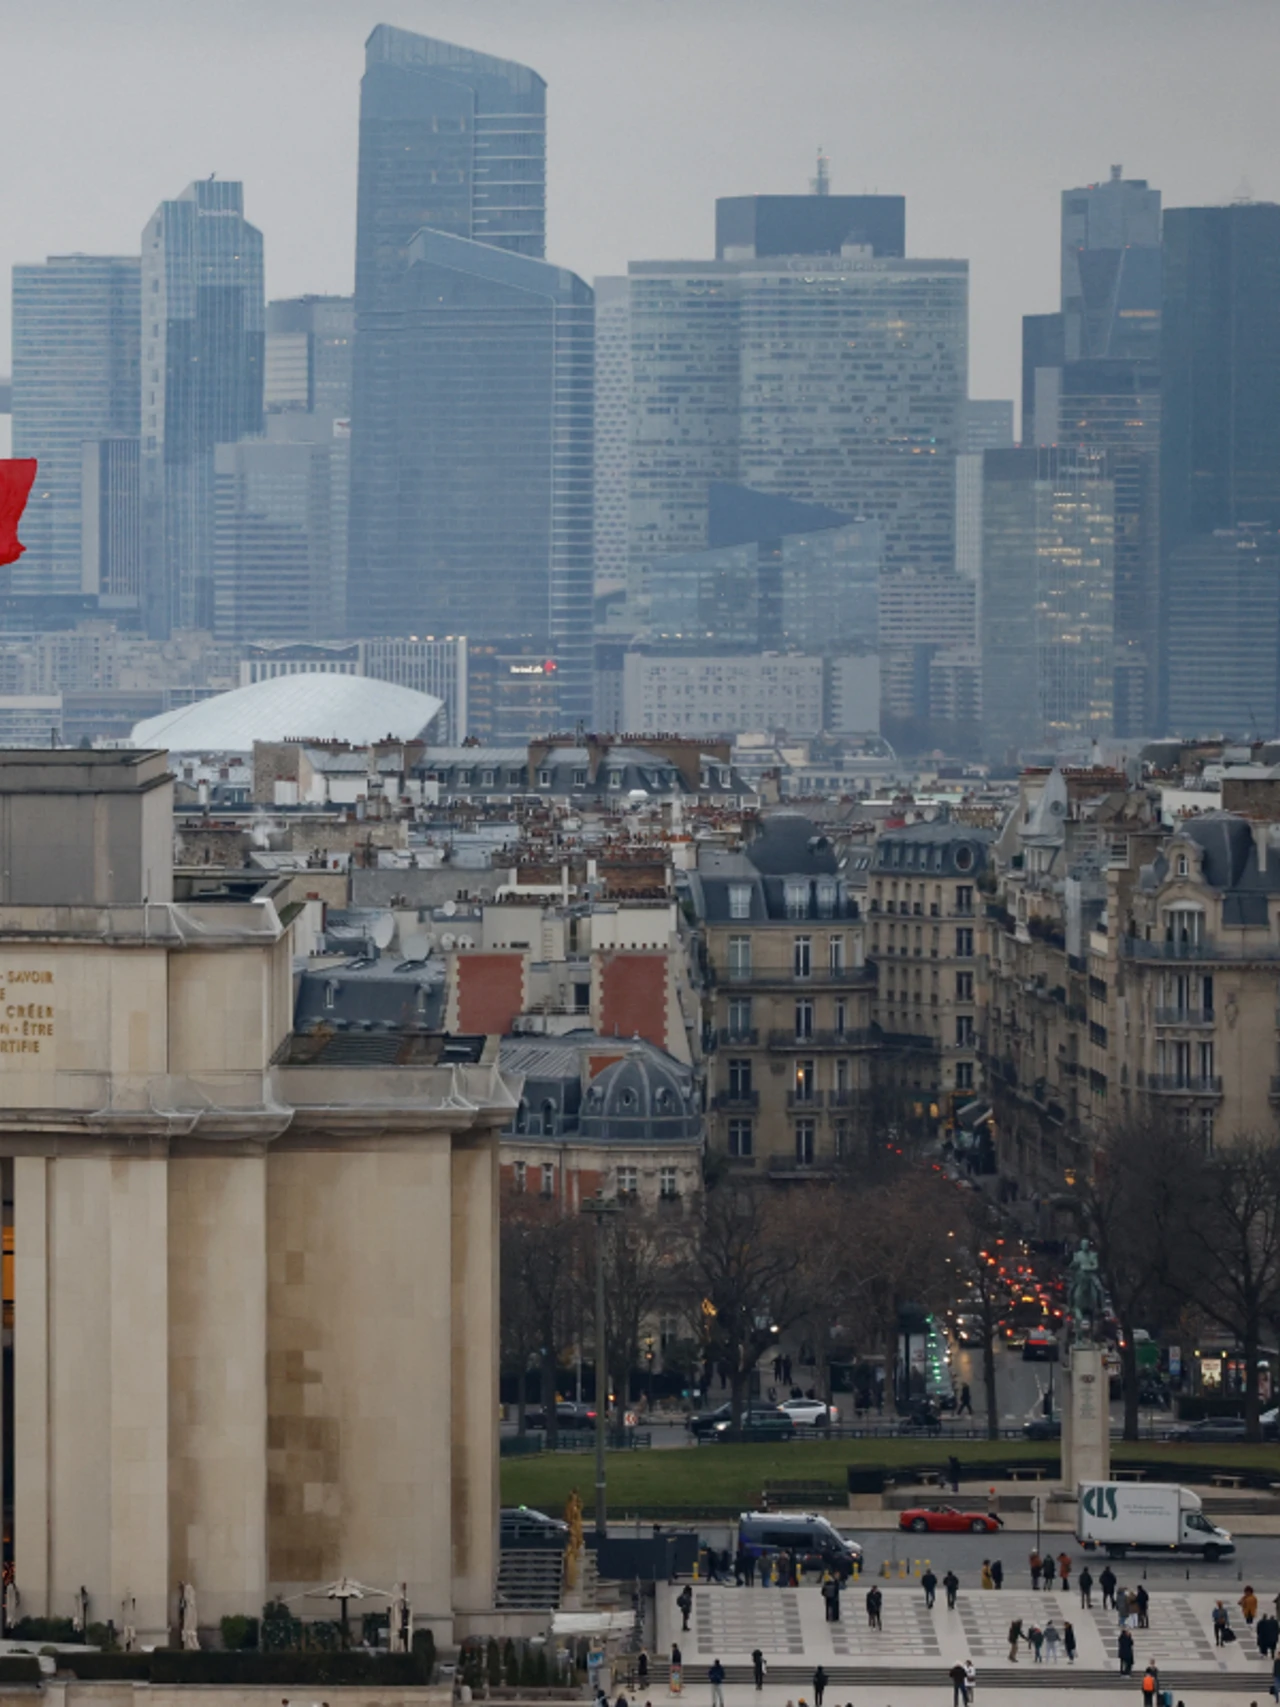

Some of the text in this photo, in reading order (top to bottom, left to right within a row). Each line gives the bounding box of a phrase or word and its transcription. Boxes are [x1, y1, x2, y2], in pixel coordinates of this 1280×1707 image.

[7, 970, 54, 984] SAVOIR
[6, 1002, 54, 1018] CRÉER
[22, 1020, 54, 1036] ÊTRE
[1084, 1487, 1118, 1521] CLS
